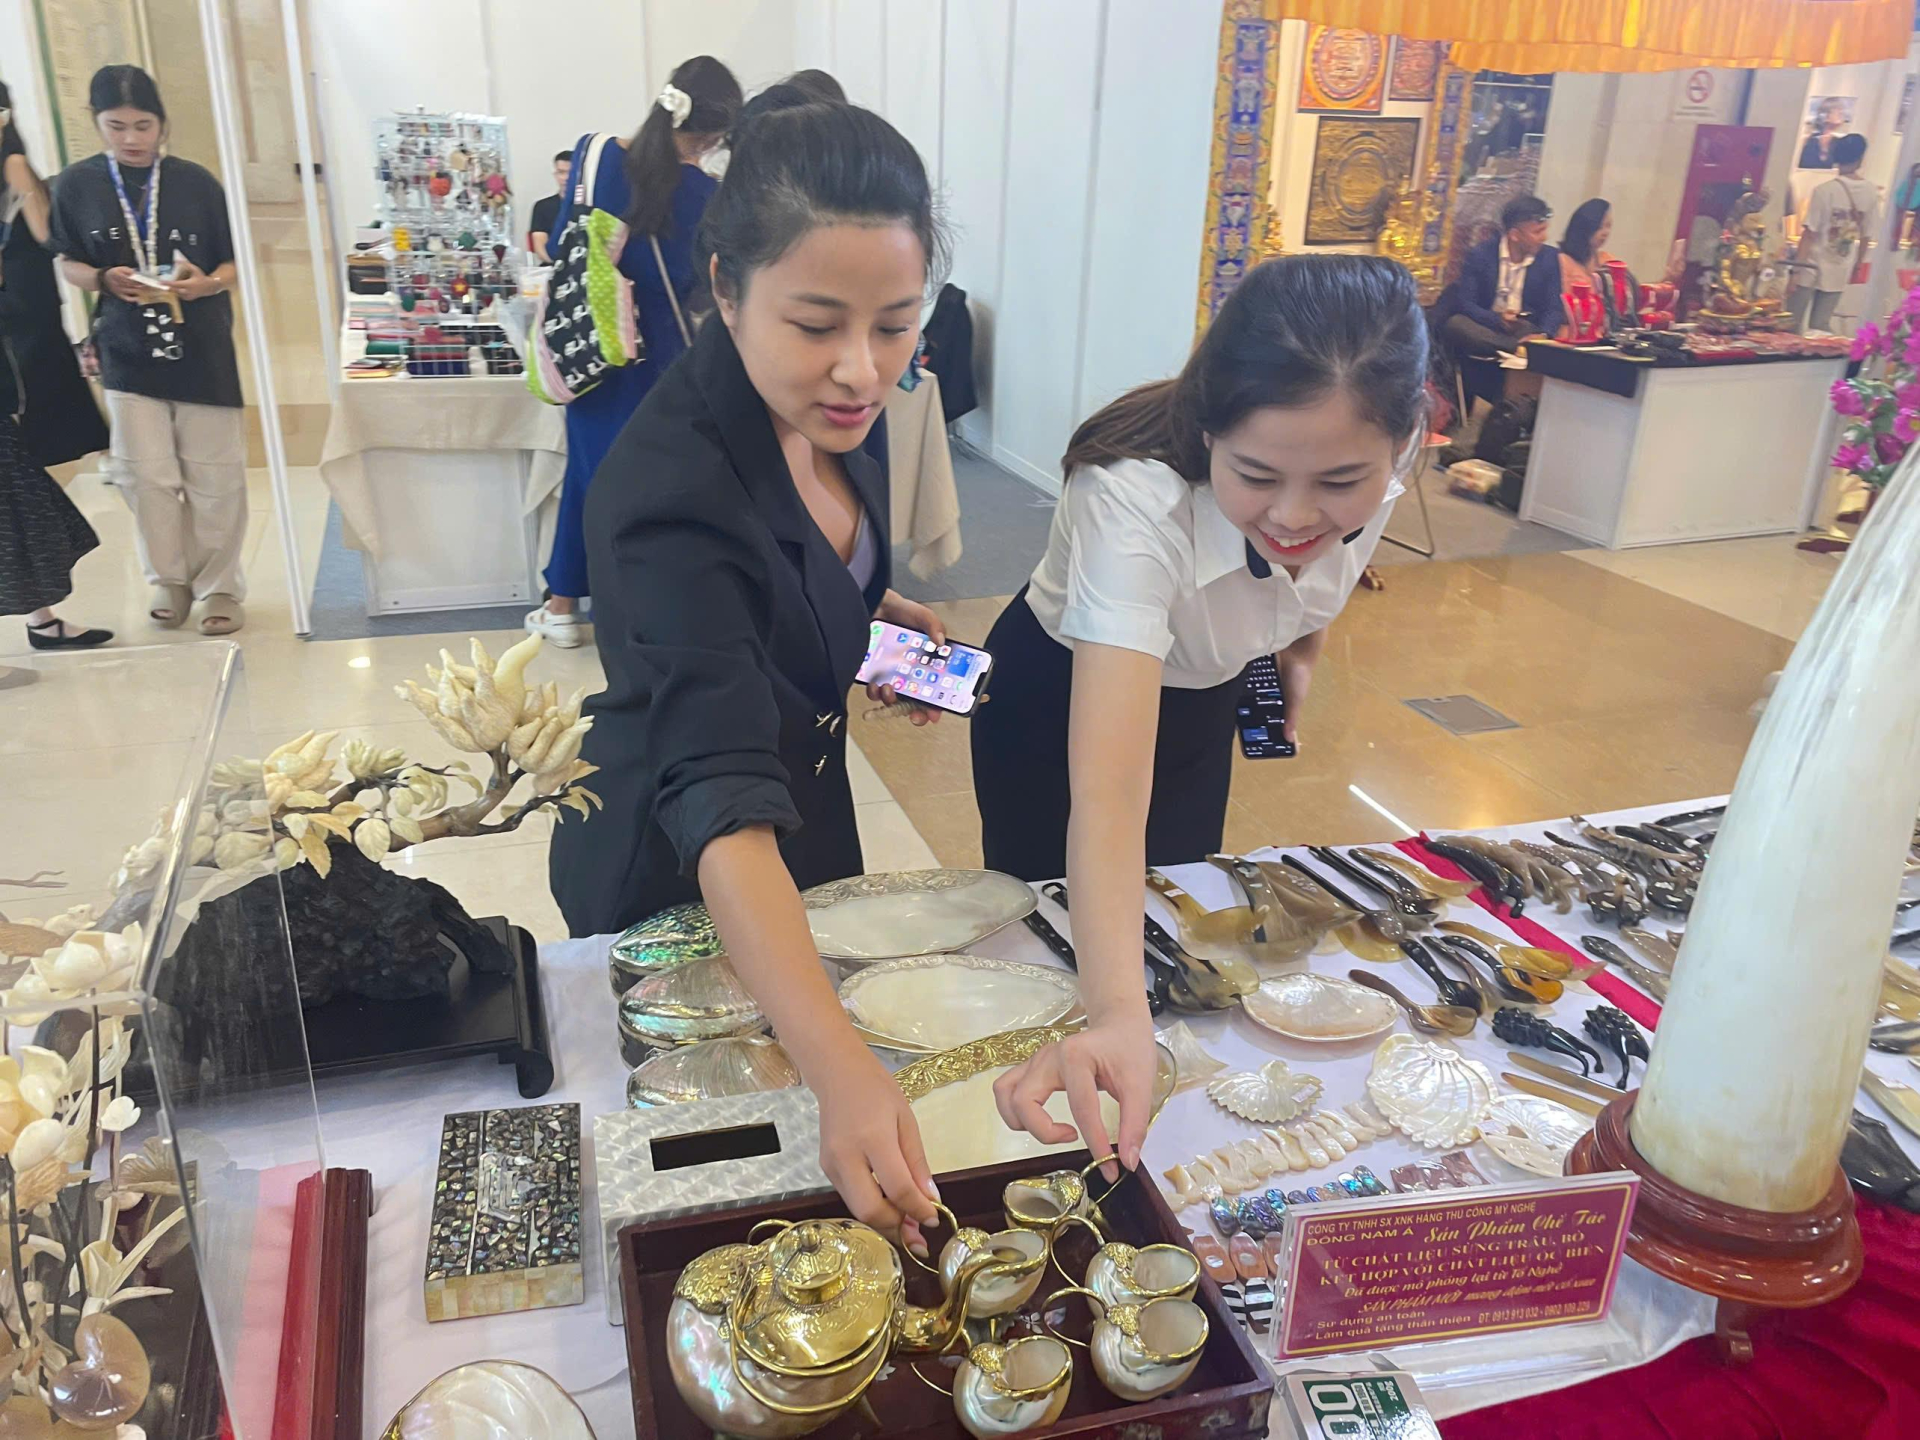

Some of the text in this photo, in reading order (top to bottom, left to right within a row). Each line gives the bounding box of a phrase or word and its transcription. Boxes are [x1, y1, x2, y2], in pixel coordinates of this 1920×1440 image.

[1338, 1221, 1349, 1231] TY
[1352, 1218, 1377, 1230] TNHH
[1379, 1217, 1392, 1227] SX
[1393, 1214, 1413, 1225] XNK
[1360, 1229, 1397, 1239] NAM
[1375, 1313, 1392, 1322] an
